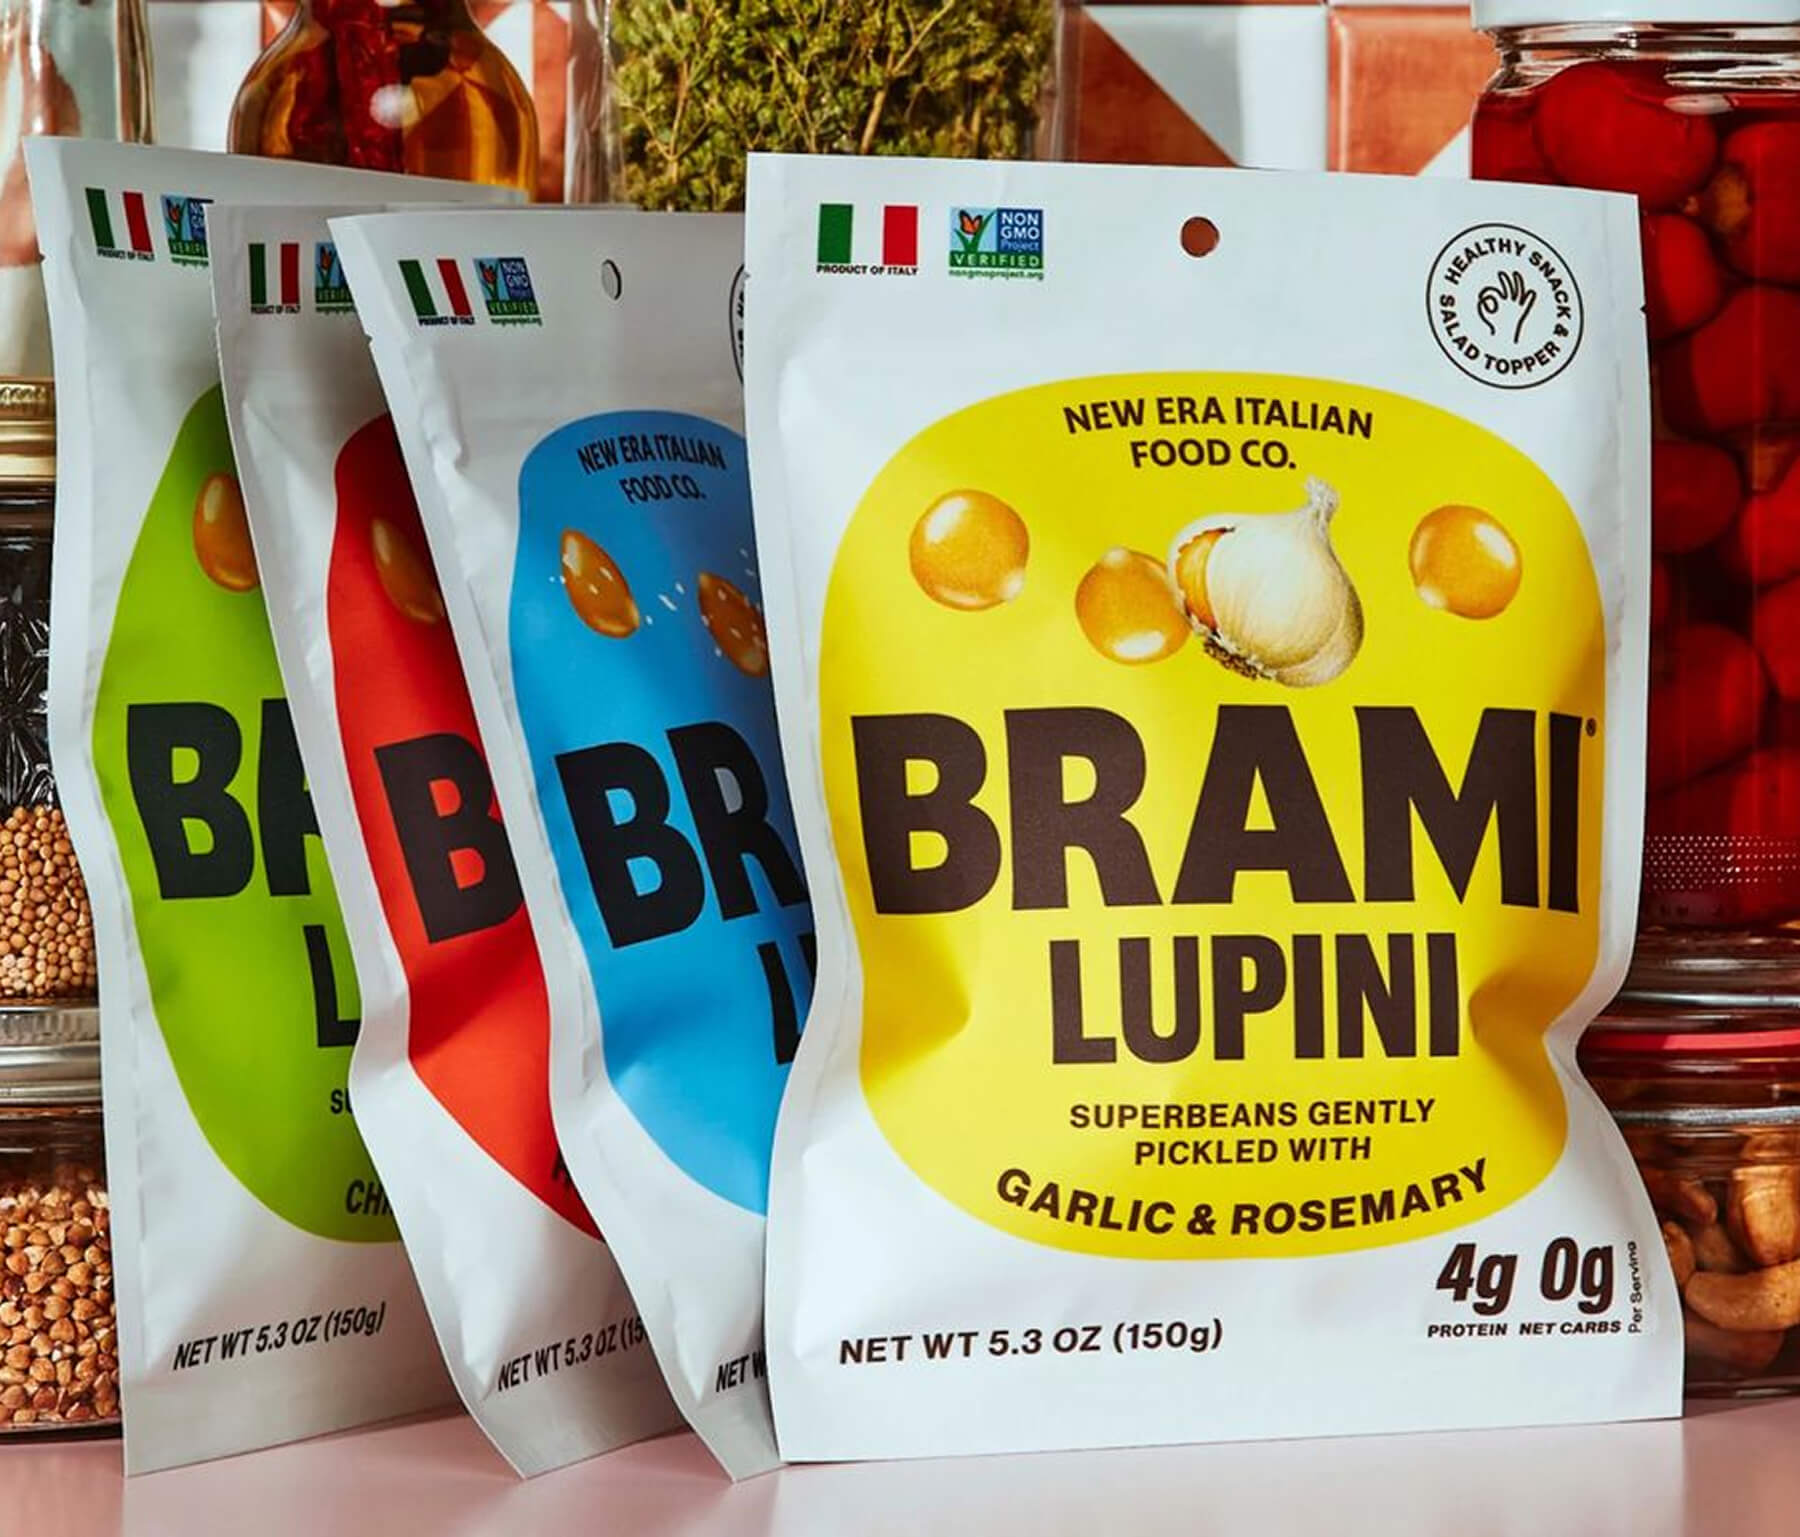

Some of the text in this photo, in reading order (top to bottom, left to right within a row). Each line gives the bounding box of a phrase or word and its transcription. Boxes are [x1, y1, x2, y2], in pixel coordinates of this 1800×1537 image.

[1001, 212, 1039, 225] NON
[1001, 226, 1041, 240] GMO
[816, 264, 918, 276] PRODUCT OF ITALY
[948, 269, 1044, 281] nongmoproject.org
[953, 253, 1041, 268] VERIFIED
[1440, 237, 1572, 375] HEALTHY SNACK & SALAD TOPPER
[1063, 397, 1373, 439] NEW ERA ITALIAN
[577, 434, 726, 475] NEW ERA ITALIAN
[1130, 438, 1297, 469] FOOD CO.
[619, 473, 707, 504] FOOD CO.
[851, 704, 1583, 915] BRAMI
[1048, 932, 1461, 1065] LUPINI
[1069, 1099, 1436, 1129] SUPERBEANS GENTLY
[1134, 1136, 1372, 1166] PICKLED WITH
[996, 1158, 1487, 1236] GARLIC & ROSEMARY
[1436, 1236, 1615, 1316] 4g 0g
[173, 1301, 386, 1370] NET WT 5.3 OZ (150g)
[1428, 1321, 1622, 1337] PROTEIN NET CARBS
[1628, 1306, 1643, 1334] Per
[498, 1315, 649, 1391] NET WT 5.3 OZ (15
[839, 1318, 1223, 1364] NET WT 5.3 OZ (150g)
[715, 1353, 750, 1392] NET
